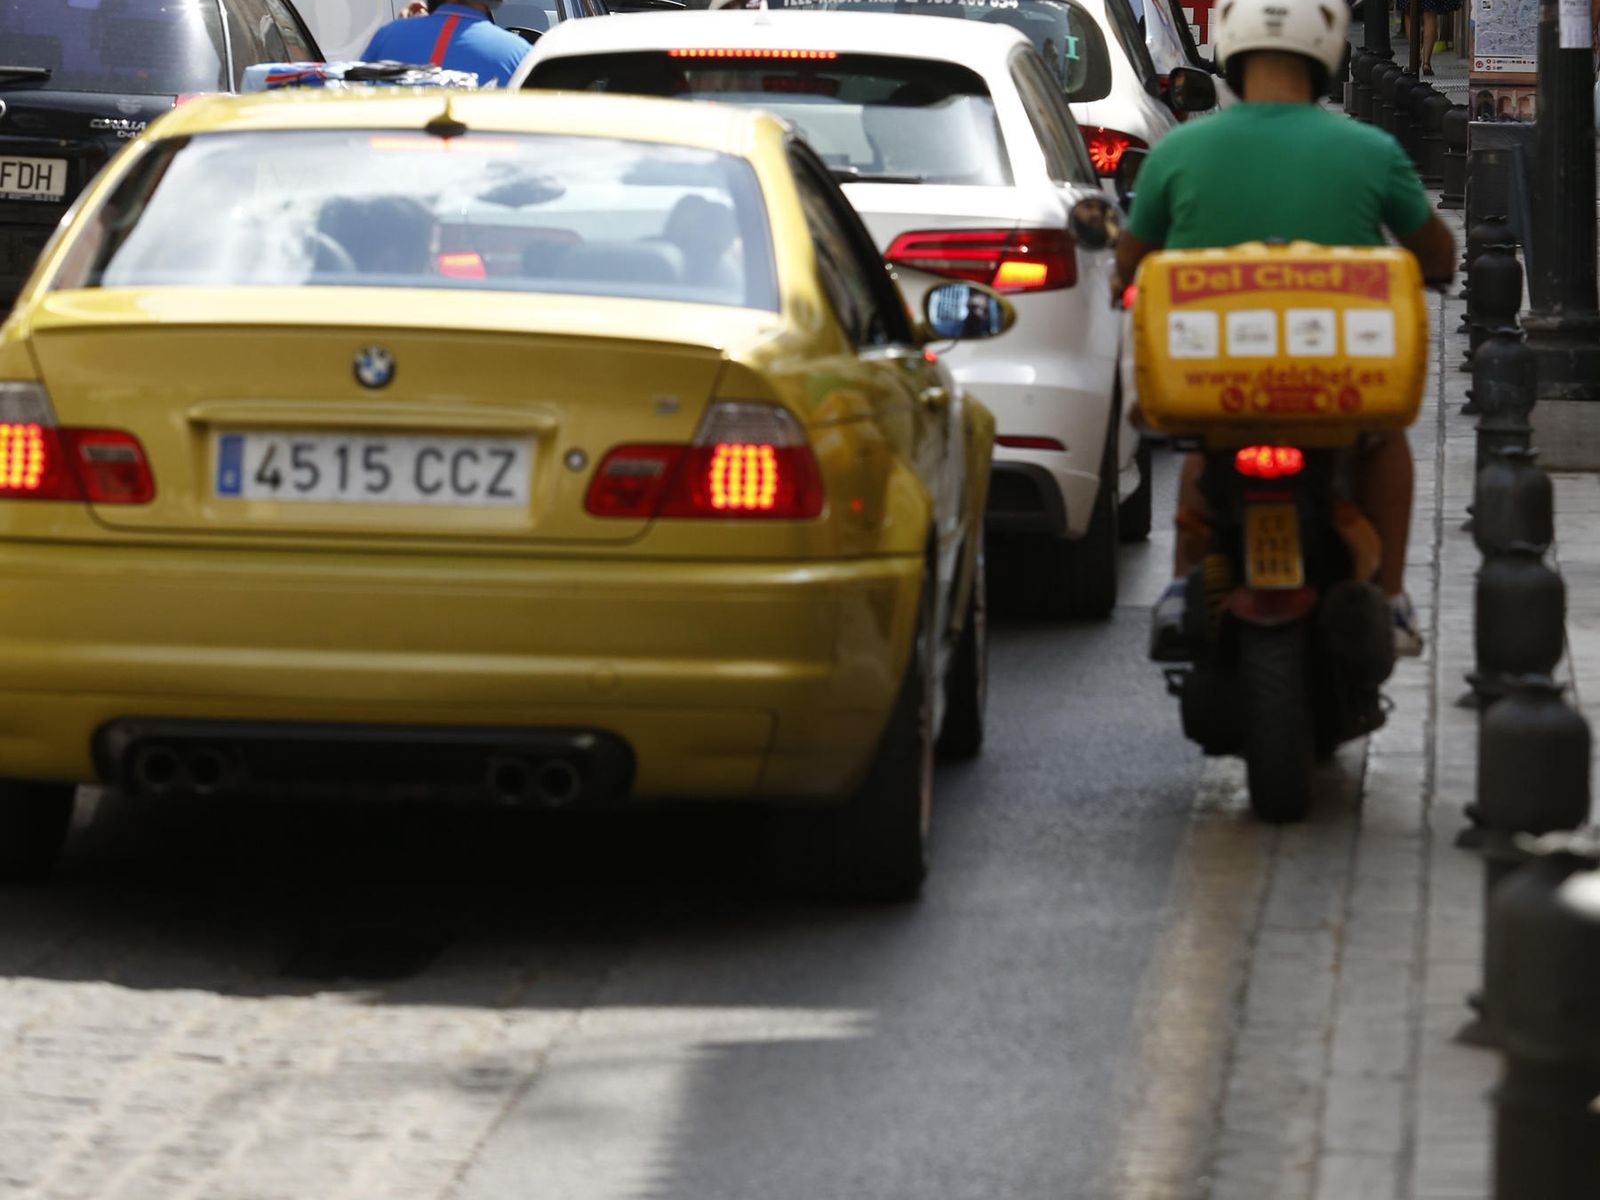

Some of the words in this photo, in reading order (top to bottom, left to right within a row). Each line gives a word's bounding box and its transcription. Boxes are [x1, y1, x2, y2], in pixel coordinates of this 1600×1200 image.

[0, 161, 52, 191] FDH
[1177, 266, 1243, 292] Del
[1253, 263, 1344, 290] Chef
[254, 442, 393, 495] 4515
[412, 446, 516, 497] CCZ
